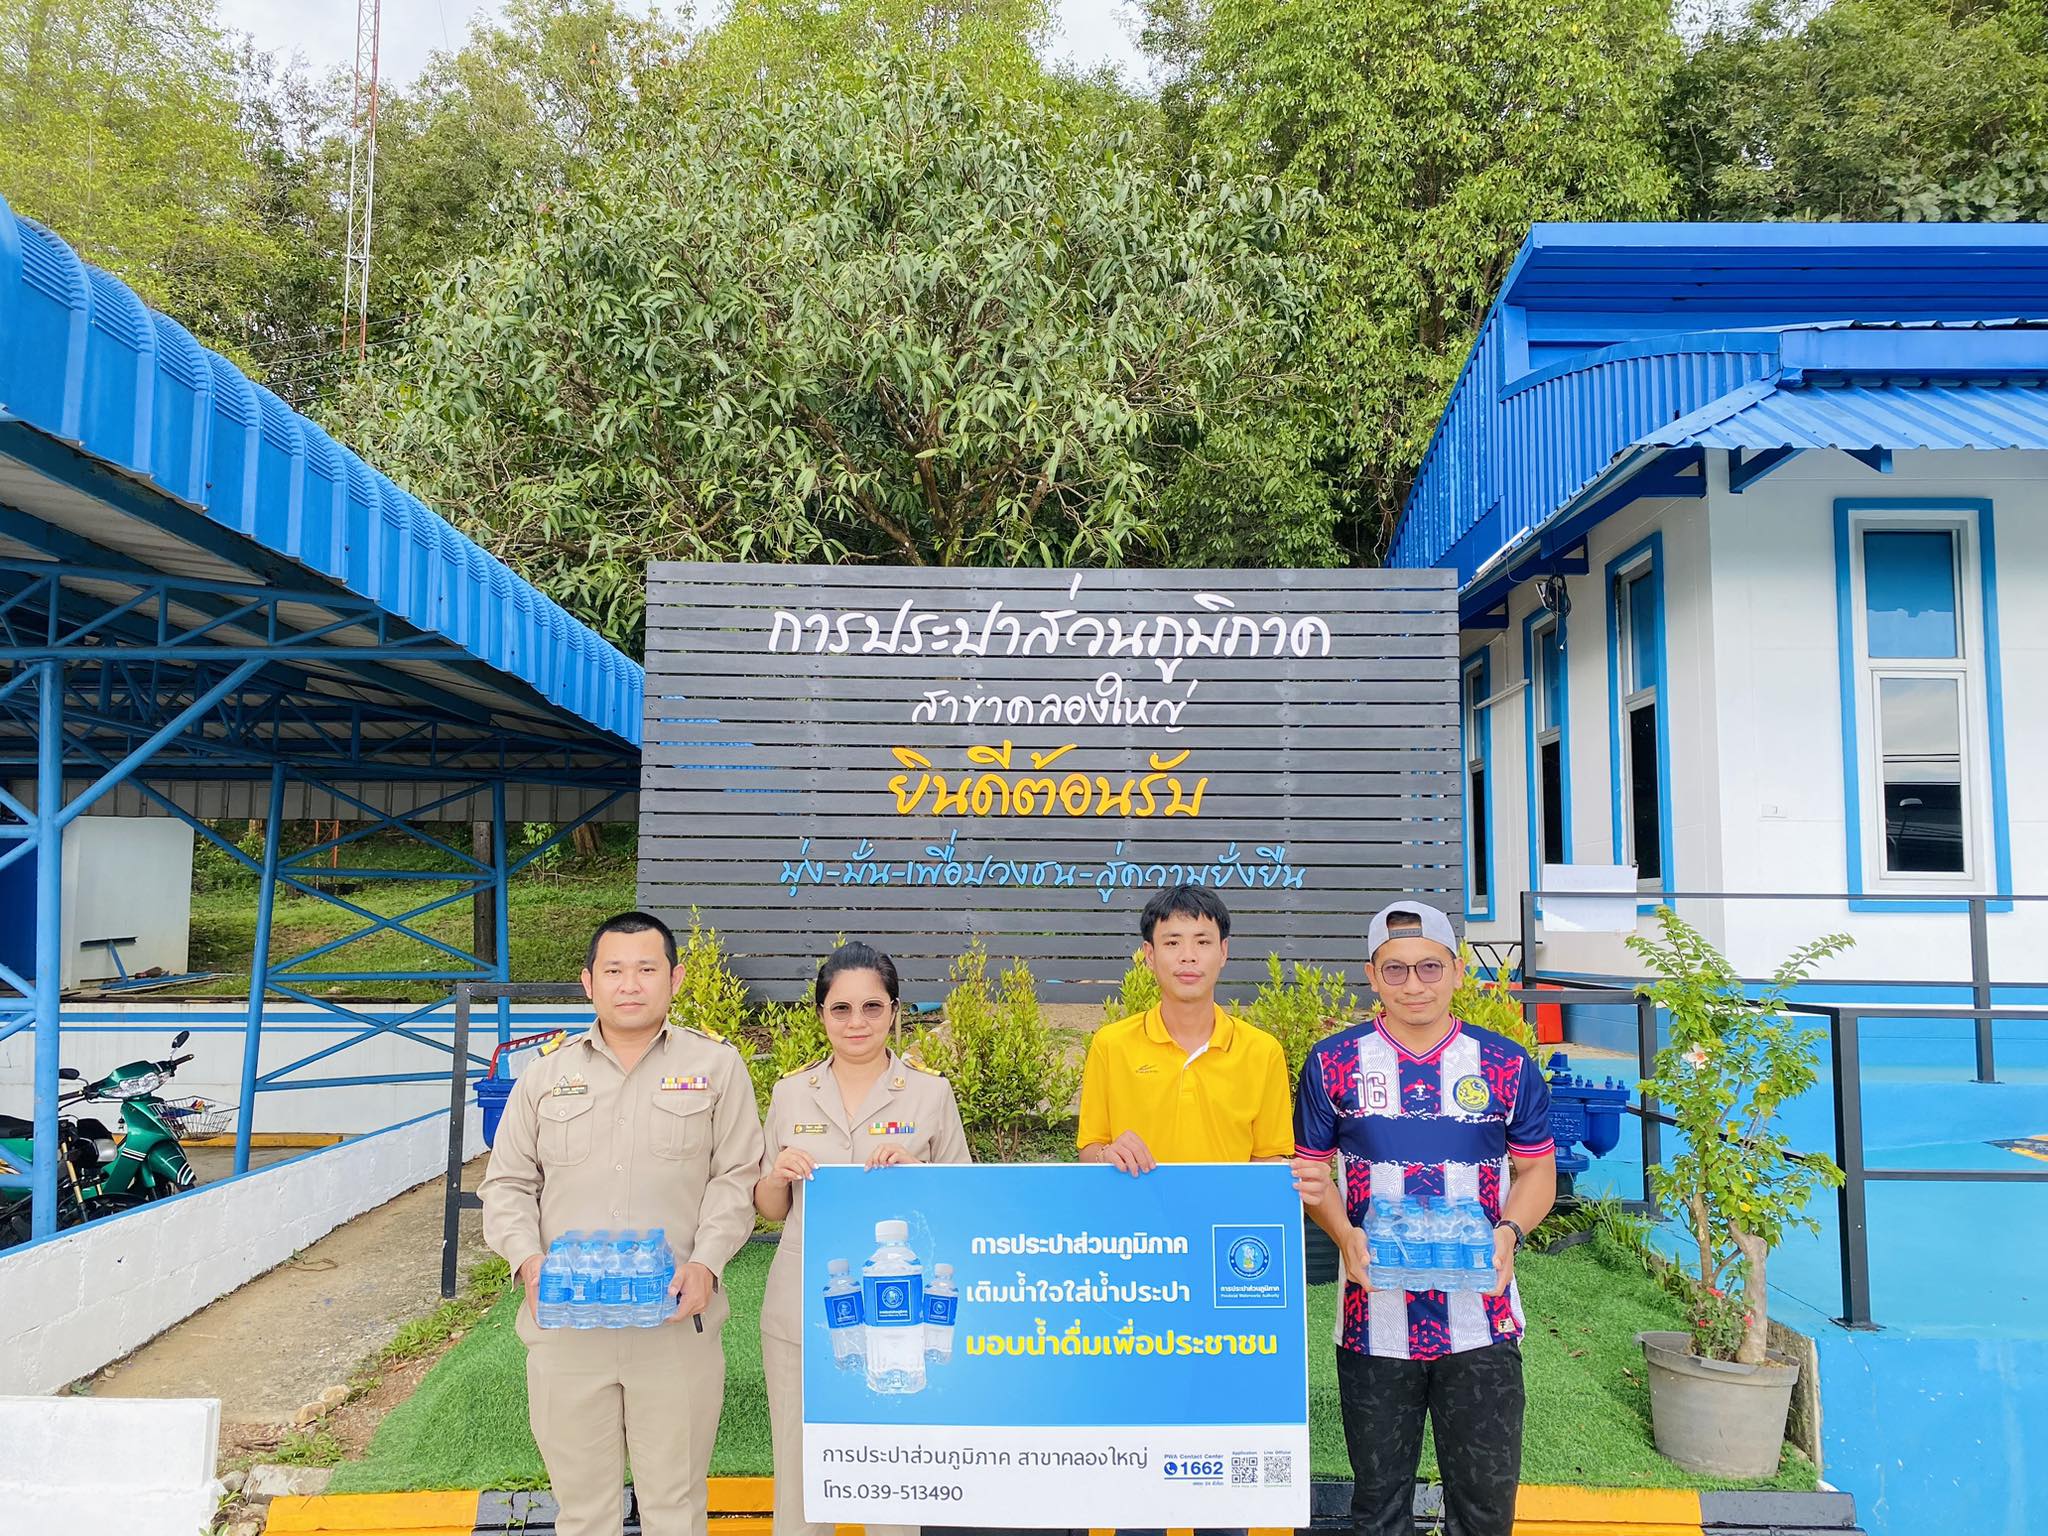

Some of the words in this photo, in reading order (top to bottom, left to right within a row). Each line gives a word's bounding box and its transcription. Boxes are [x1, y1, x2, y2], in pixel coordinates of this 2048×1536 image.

[768, 572, 1331, 683] การประปาส่วนภูมิภาค
[911, 671, 1198, 733] สาขาคลองใหญ่
[888, 740, 1209, 817] ยินดีต้อนรับ
[1352, 1071, 1388, 1109] 16
[971, 1232, 1188, 1260] การประปาส่วนภูมิภาค
[966, 1271, 1191, 1304] เติมน้ำใจใส่น้ำประปา
[966, 1318, 1278, 1356] มอบน้ำดื่มเพื่อประชาชน
[822, 1445, 1011, 1470] การประปาส่วนภูมิภาค
[1018, 1447, 1148, 1470] สาขาคลองใหญ่
[1180, 1461, 1224, 1476] 1662
[823, 1480, 964, 1503] โทร.039-513490
